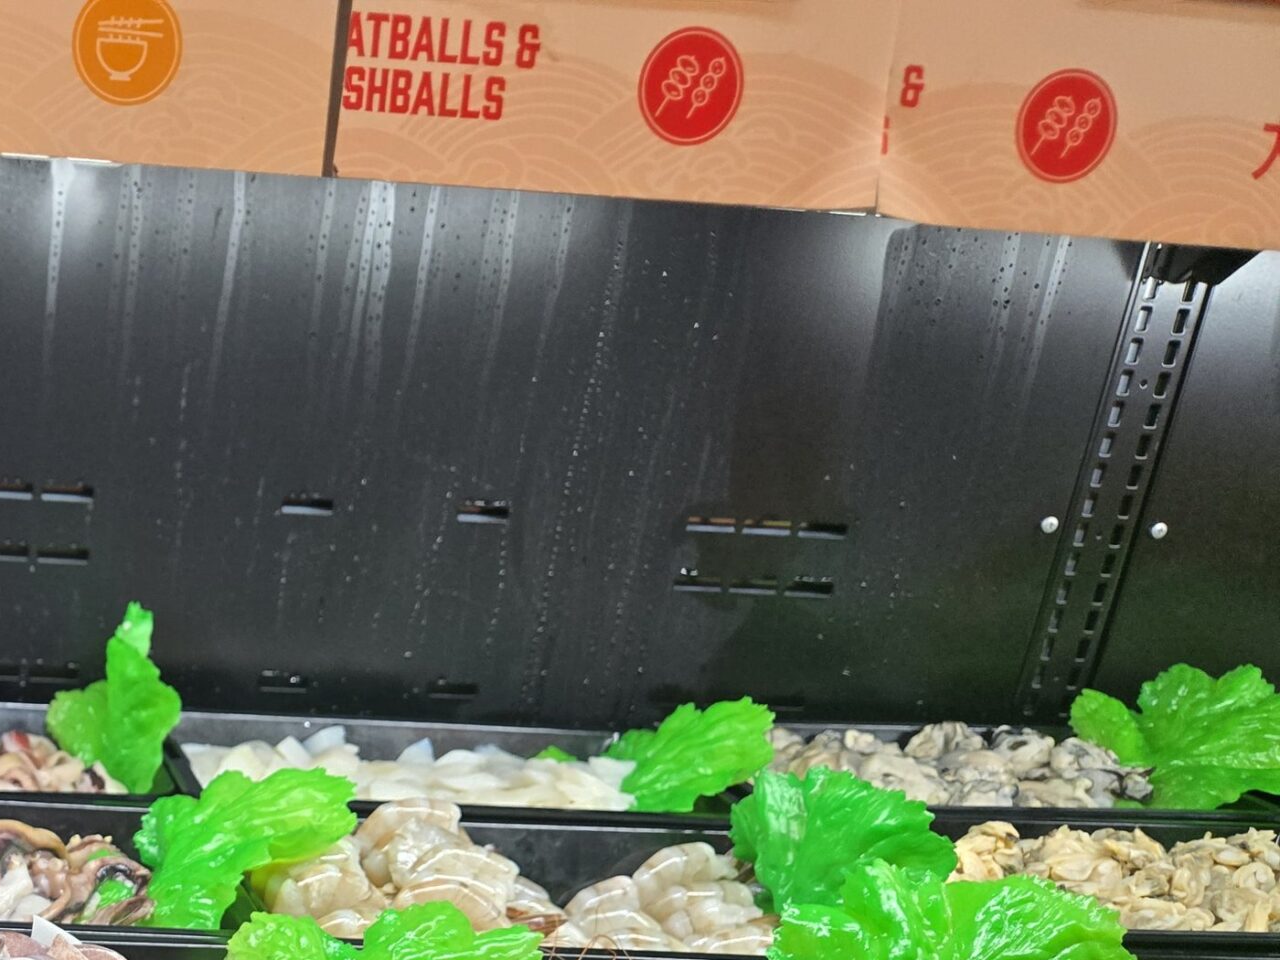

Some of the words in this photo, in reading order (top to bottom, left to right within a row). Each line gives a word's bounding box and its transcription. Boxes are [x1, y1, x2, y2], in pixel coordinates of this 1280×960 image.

[347, 11, 507, 66] ATBALLS
[515, 24, 541, 69] &
[342, 66, 507, 120] SHBALLS
[900, 64, 925, 108] &
